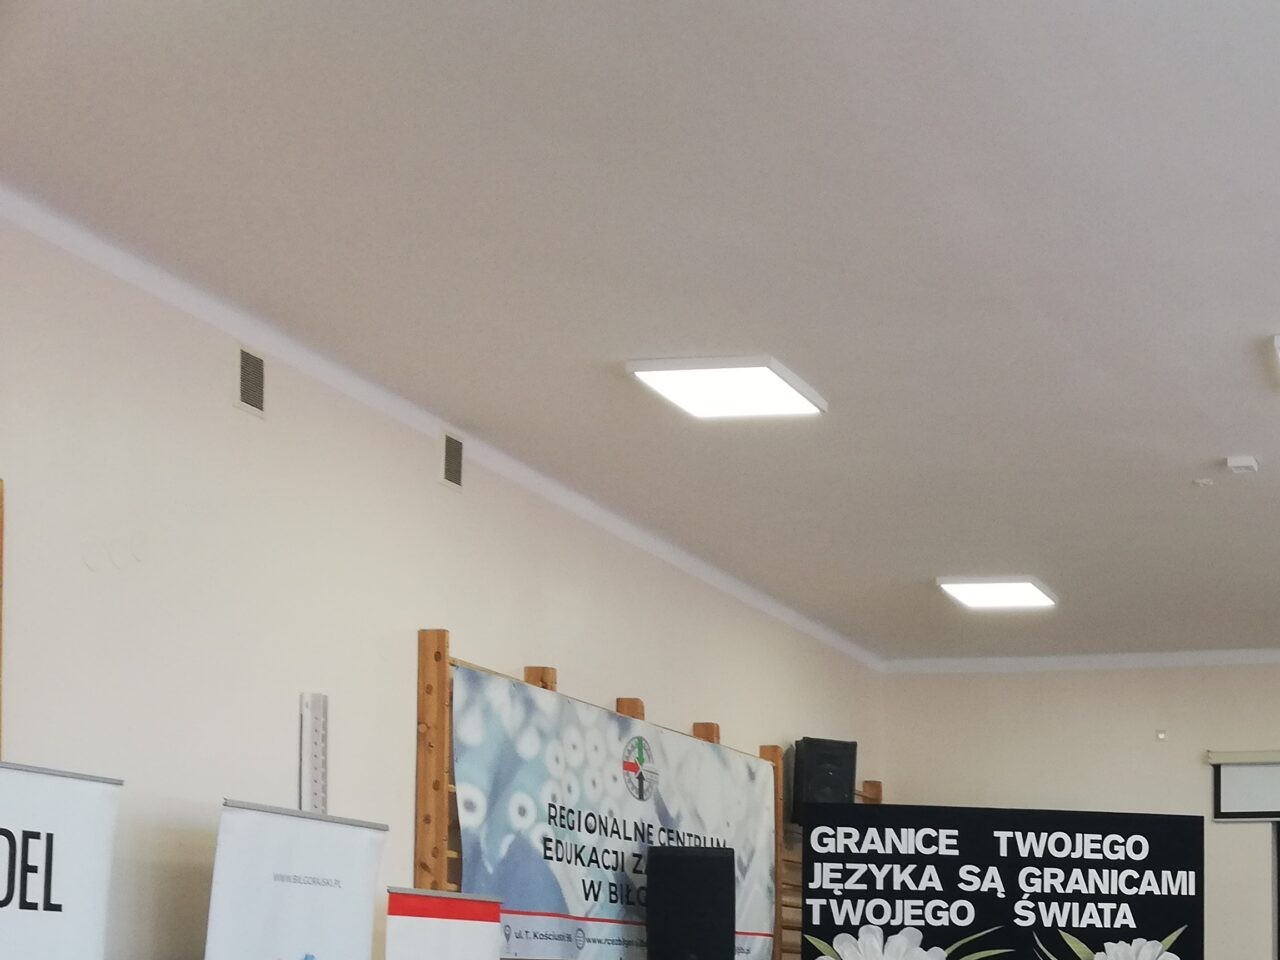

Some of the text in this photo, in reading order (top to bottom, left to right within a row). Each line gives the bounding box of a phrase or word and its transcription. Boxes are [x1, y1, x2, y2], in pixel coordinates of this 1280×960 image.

[548, 803, 654, 845] REGIONALNE
[543, 837, 625, 873] EDUKACJI
[809, 826, 1150, 860] GRANICE TWOJEGO
[581, 879, 602, 902] W
[808, 862, 1196, 898] JĘZYKA SĄ GRANICAMI
[806, 893, 1136, 928] TWOJEGO ŚWIATA
